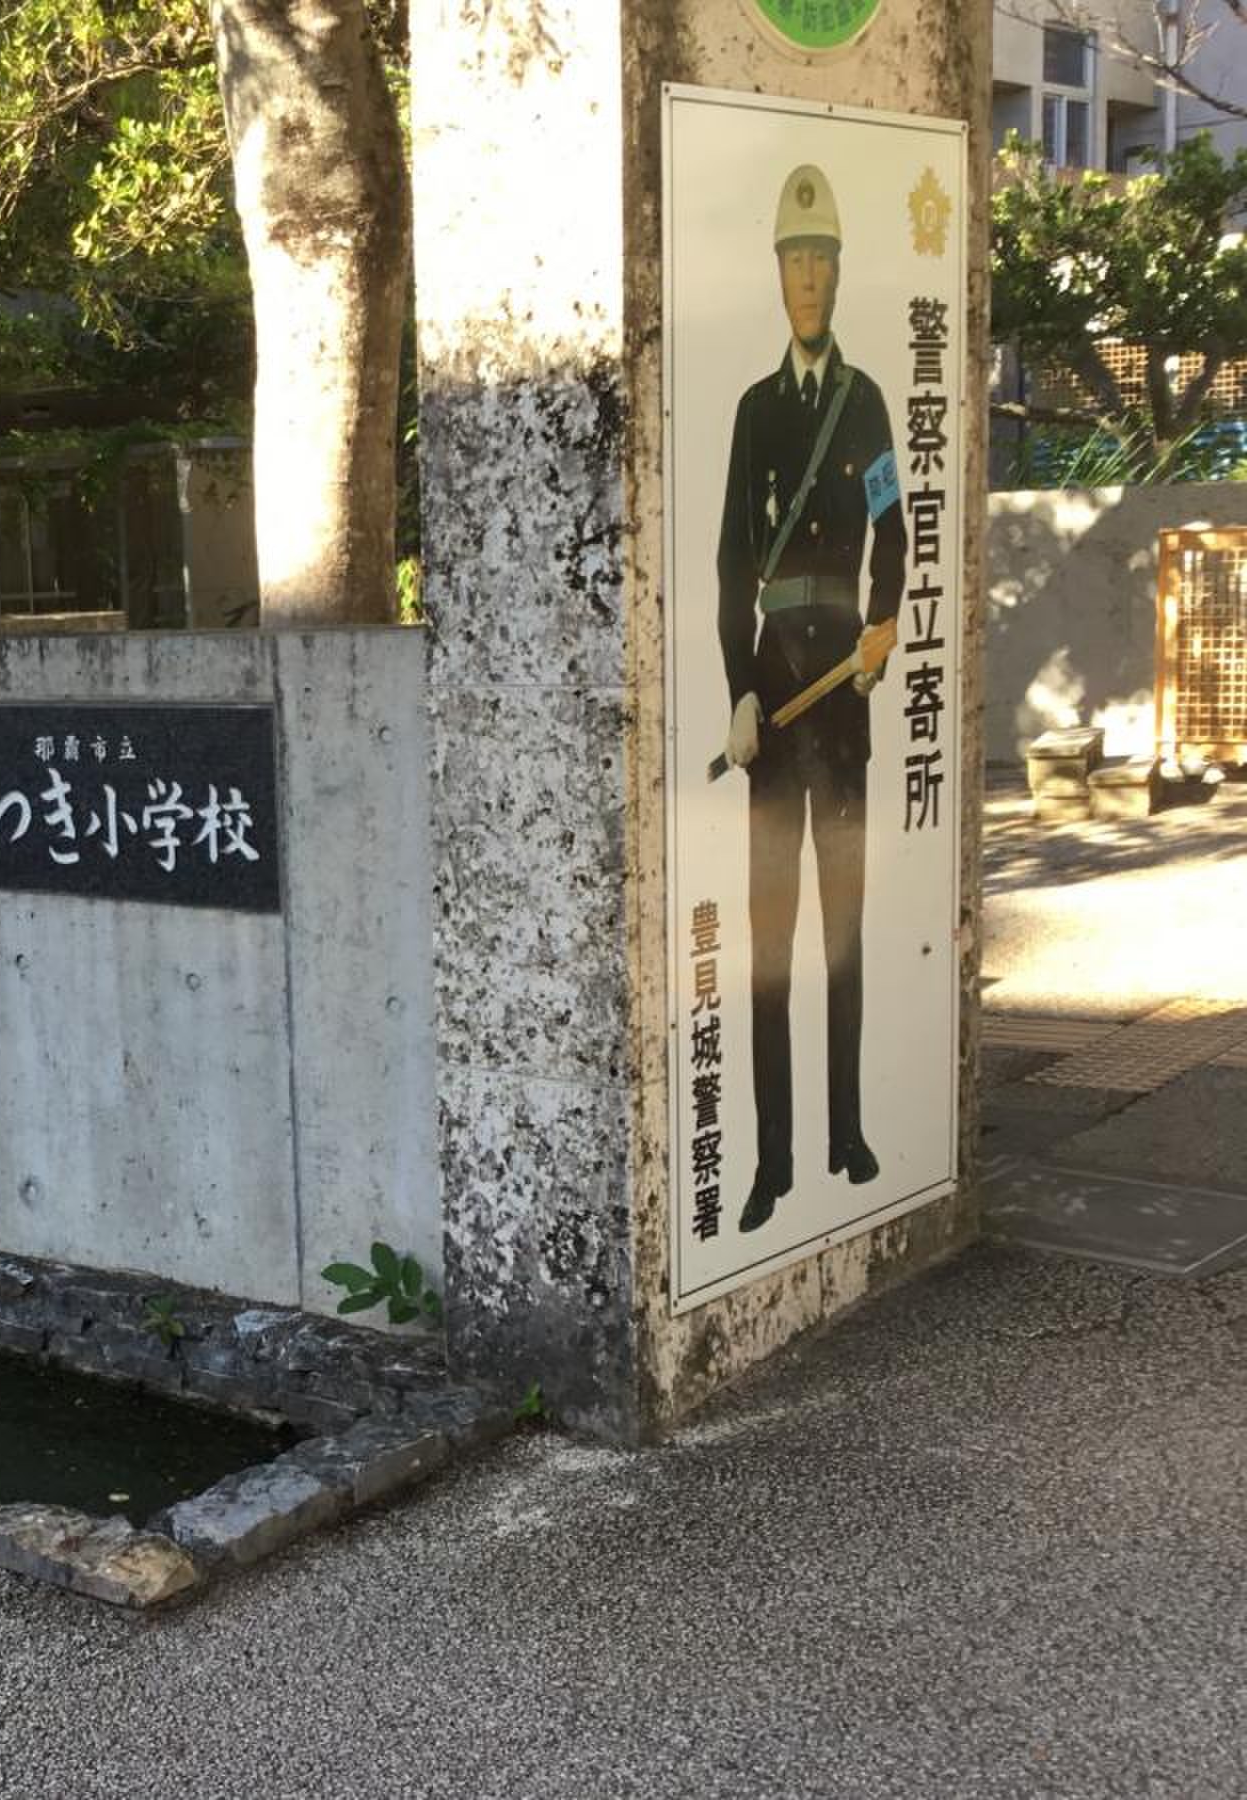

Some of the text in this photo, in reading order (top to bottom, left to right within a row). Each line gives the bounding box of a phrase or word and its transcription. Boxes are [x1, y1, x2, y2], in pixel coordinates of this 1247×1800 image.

[904, 297, 948, 832] 警察官立寄所
[34, 734, 137, 762] 那覇市立
[690, 899, 723, 1243] 豊見城警察署
